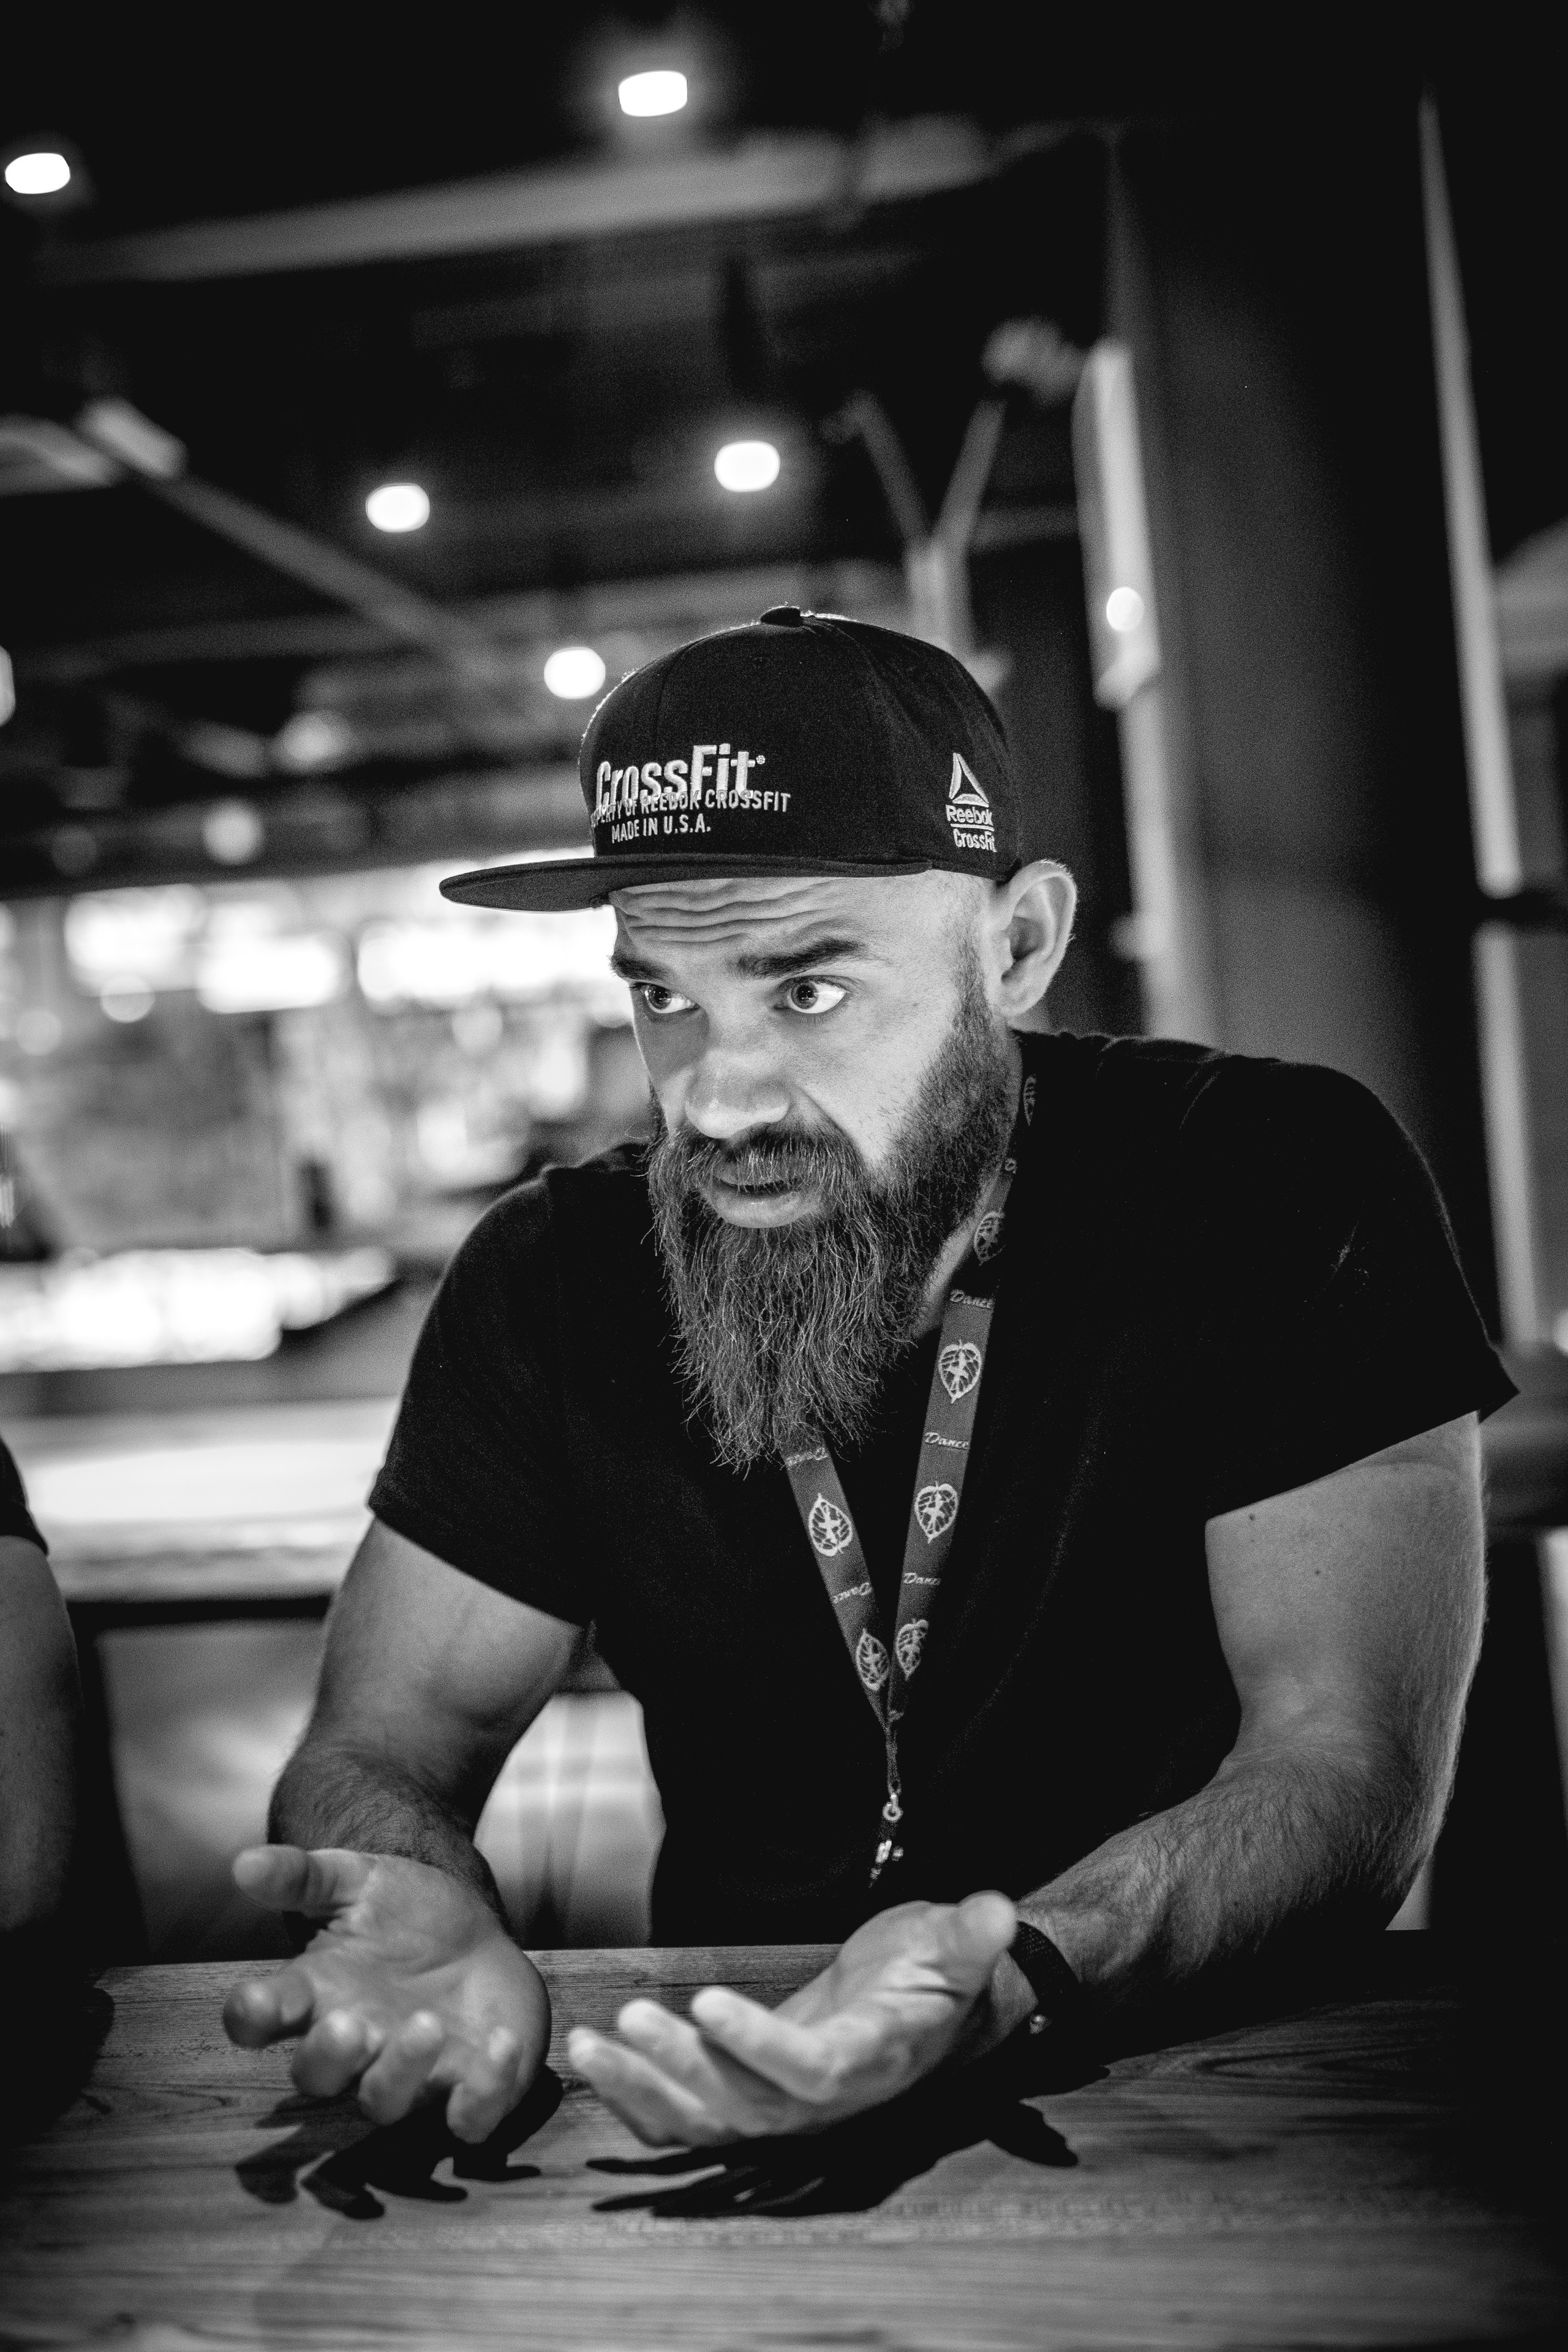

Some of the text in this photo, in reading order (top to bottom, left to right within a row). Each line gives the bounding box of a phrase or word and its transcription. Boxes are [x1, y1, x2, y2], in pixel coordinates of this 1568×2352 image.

[640, 790, 700, 815] REEBOK
[705, 789, 791, 813] CROSSFIT
[945, 804, 993, 826] Reebok
[612, 813, 711, 843] MADE IN U.S.A.
[952, 828, 997, 853] CrossFit
[925, 1432, 968, 1449] Dance
